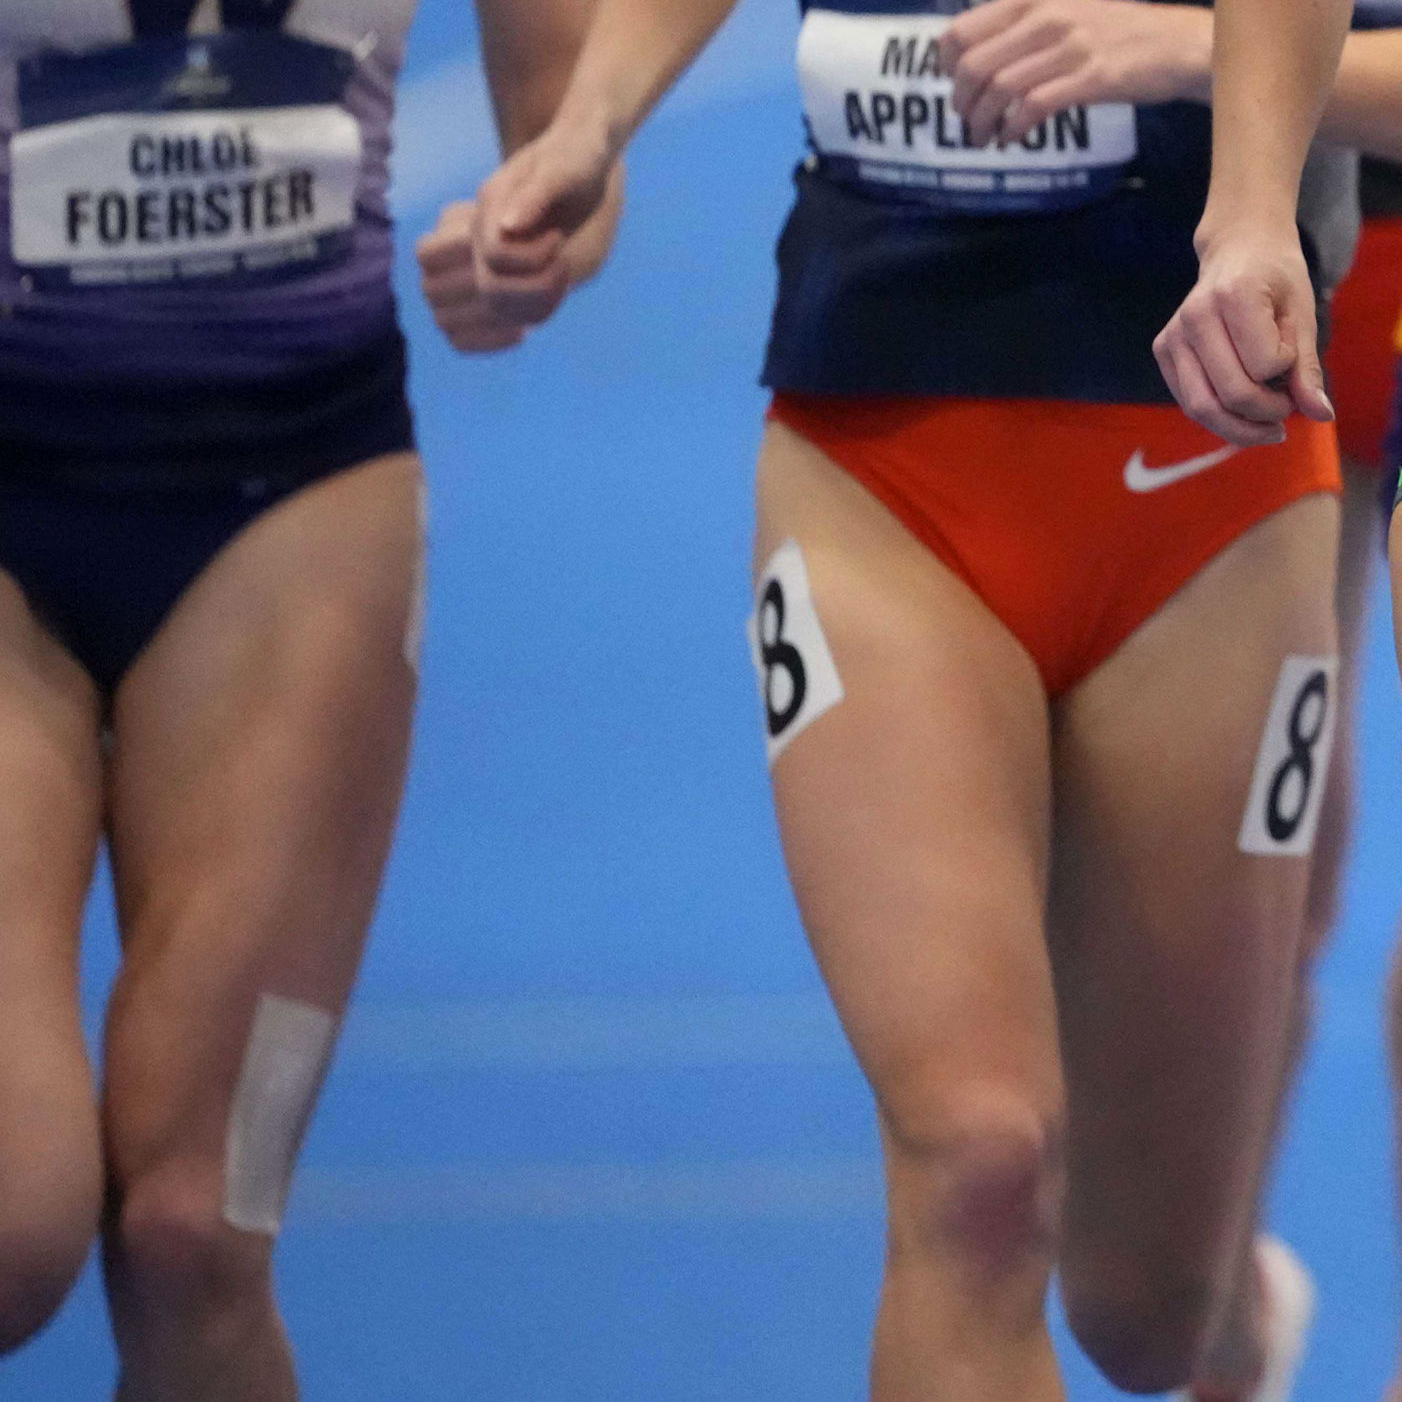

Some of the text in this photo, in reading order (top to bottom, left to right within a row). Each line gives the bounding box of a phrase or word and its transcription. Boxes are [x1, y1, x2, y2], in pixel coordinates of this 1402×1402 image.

[845, 88, 1090, 152] APPLN
[66, 166, 314, 245] FOERSTER
[758, 577, 806, 738] 8
[1265, 669, 1328, 842] 8
